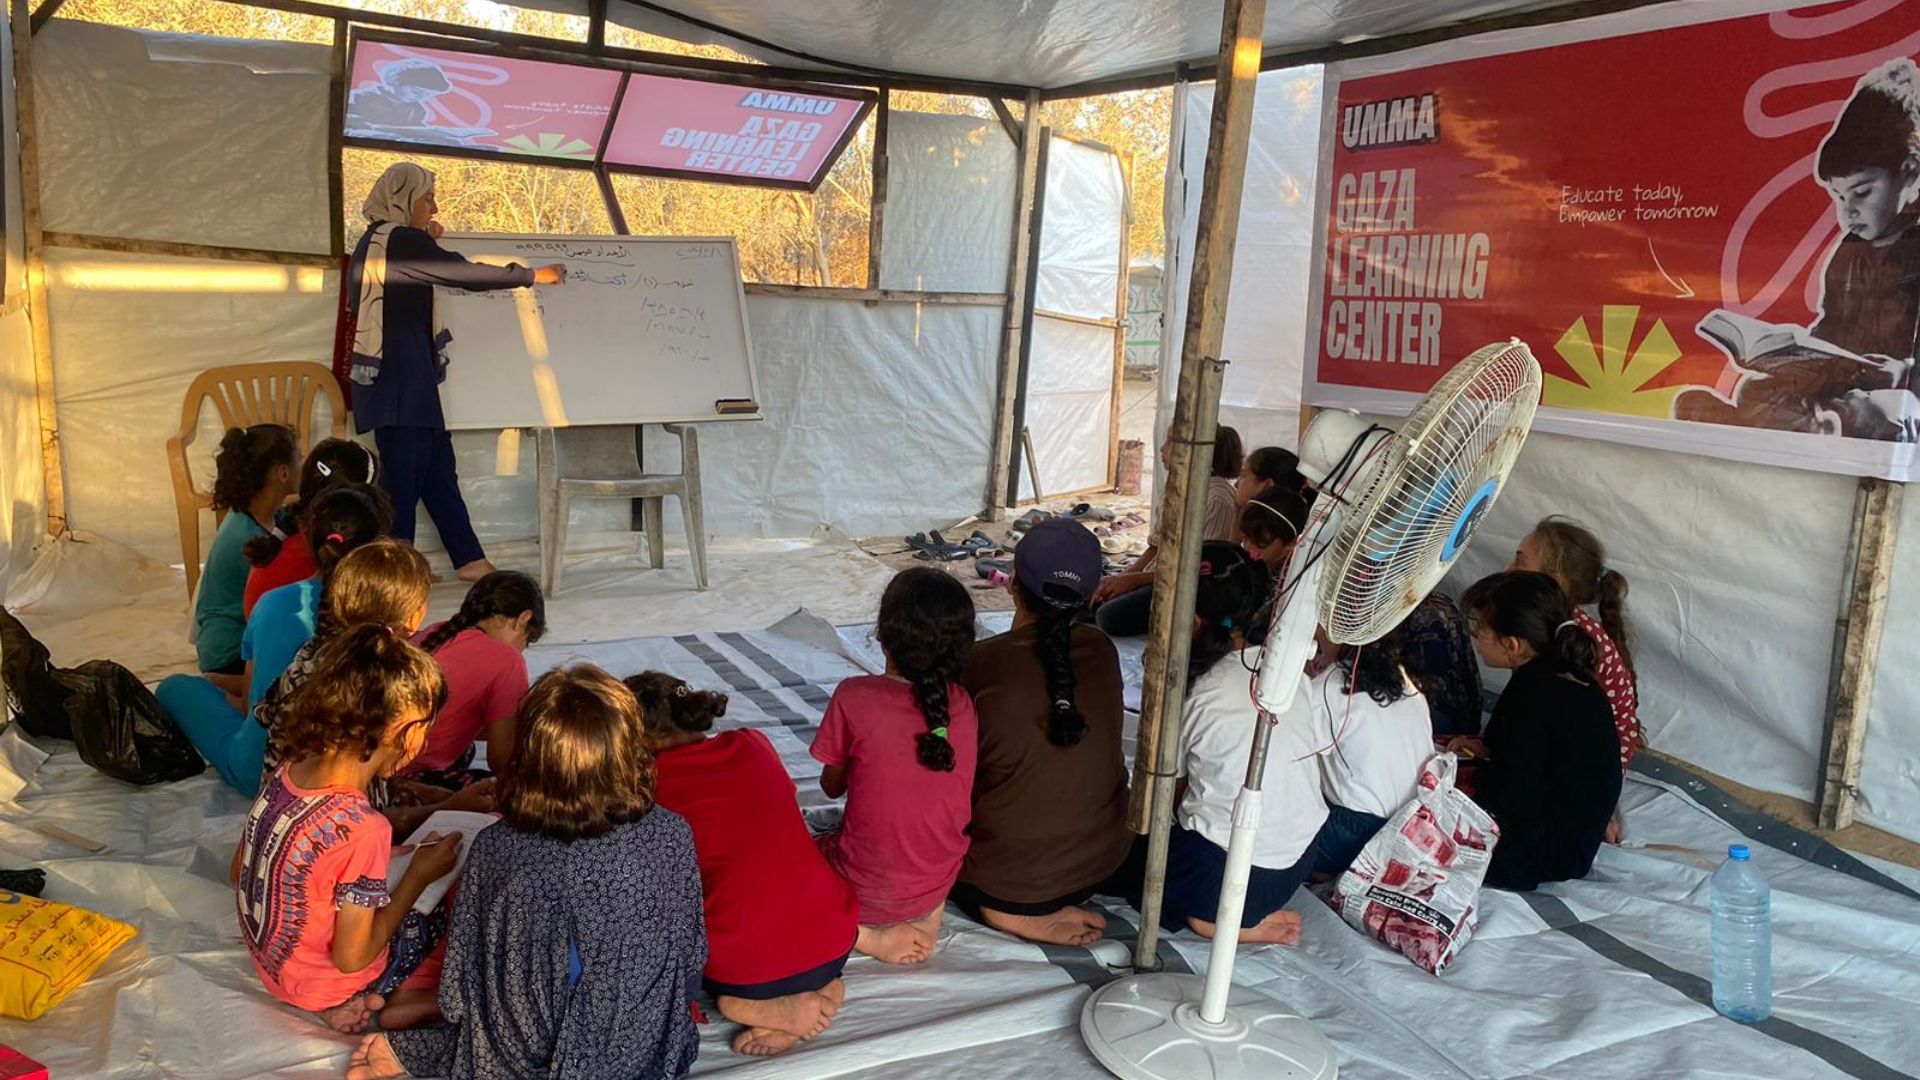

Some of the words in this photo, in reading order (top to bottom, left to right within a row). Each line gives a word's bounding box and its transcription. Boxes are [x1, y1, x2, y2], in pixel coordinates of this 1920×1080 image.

[1343, 95, 1436, 148] UMMA
[1336, 168, 1416, 233] GAZA
[1559, 205, 1626, 228] Empower
[1634, 203, 1719, 221] tomorrow
[1562, 185, 1623, 204] Educate
[1632, 182, 1683, 206] today,
[1331, 233, 1490, 299] LEARNING
[1326, 299, 1442, 366] CENTER
[1053, 570, 1081, 583] TOMMY
